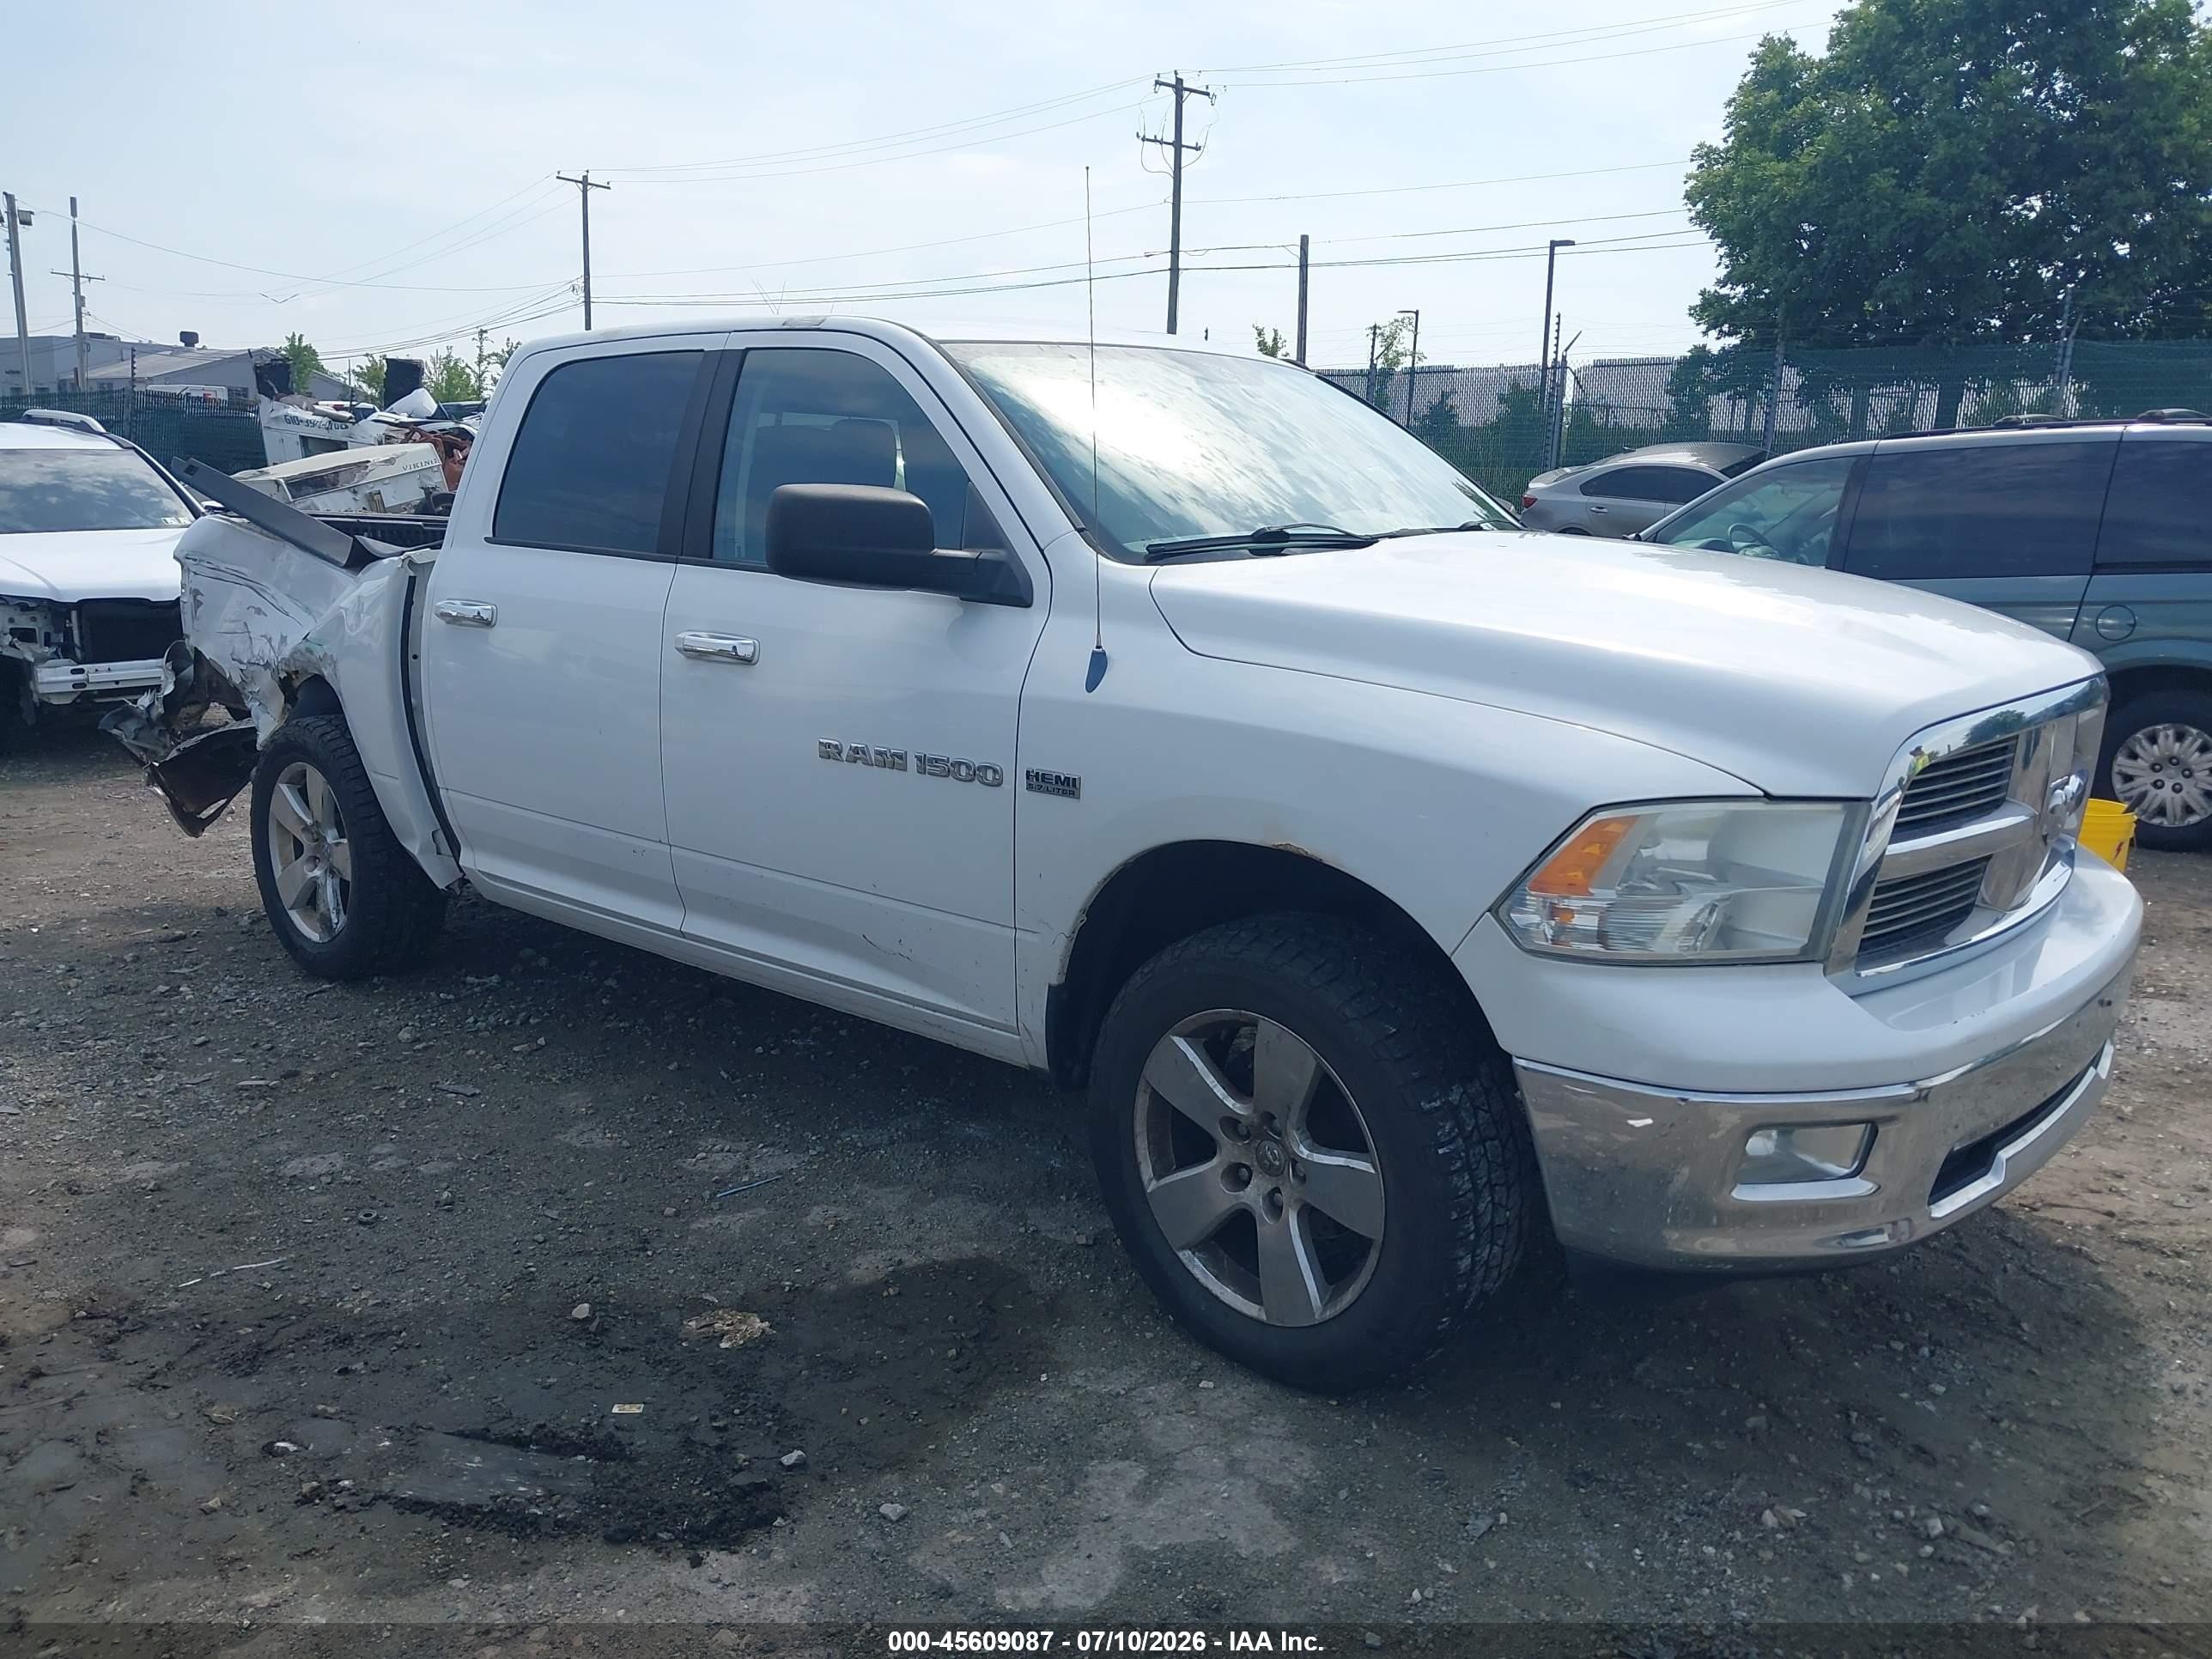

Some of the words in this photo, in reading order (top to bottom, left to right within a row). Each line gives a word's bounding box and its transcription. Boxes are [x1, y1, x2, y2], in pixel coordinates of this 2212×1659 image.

[402, 459, 438, 471] VIKING
[817, 737, 908, 773] RAM
[914, 751, 1004, 787] 1500
[1025, 769, 1077, 788] HEMI
[1046, 785, 1076, 797] LITER
